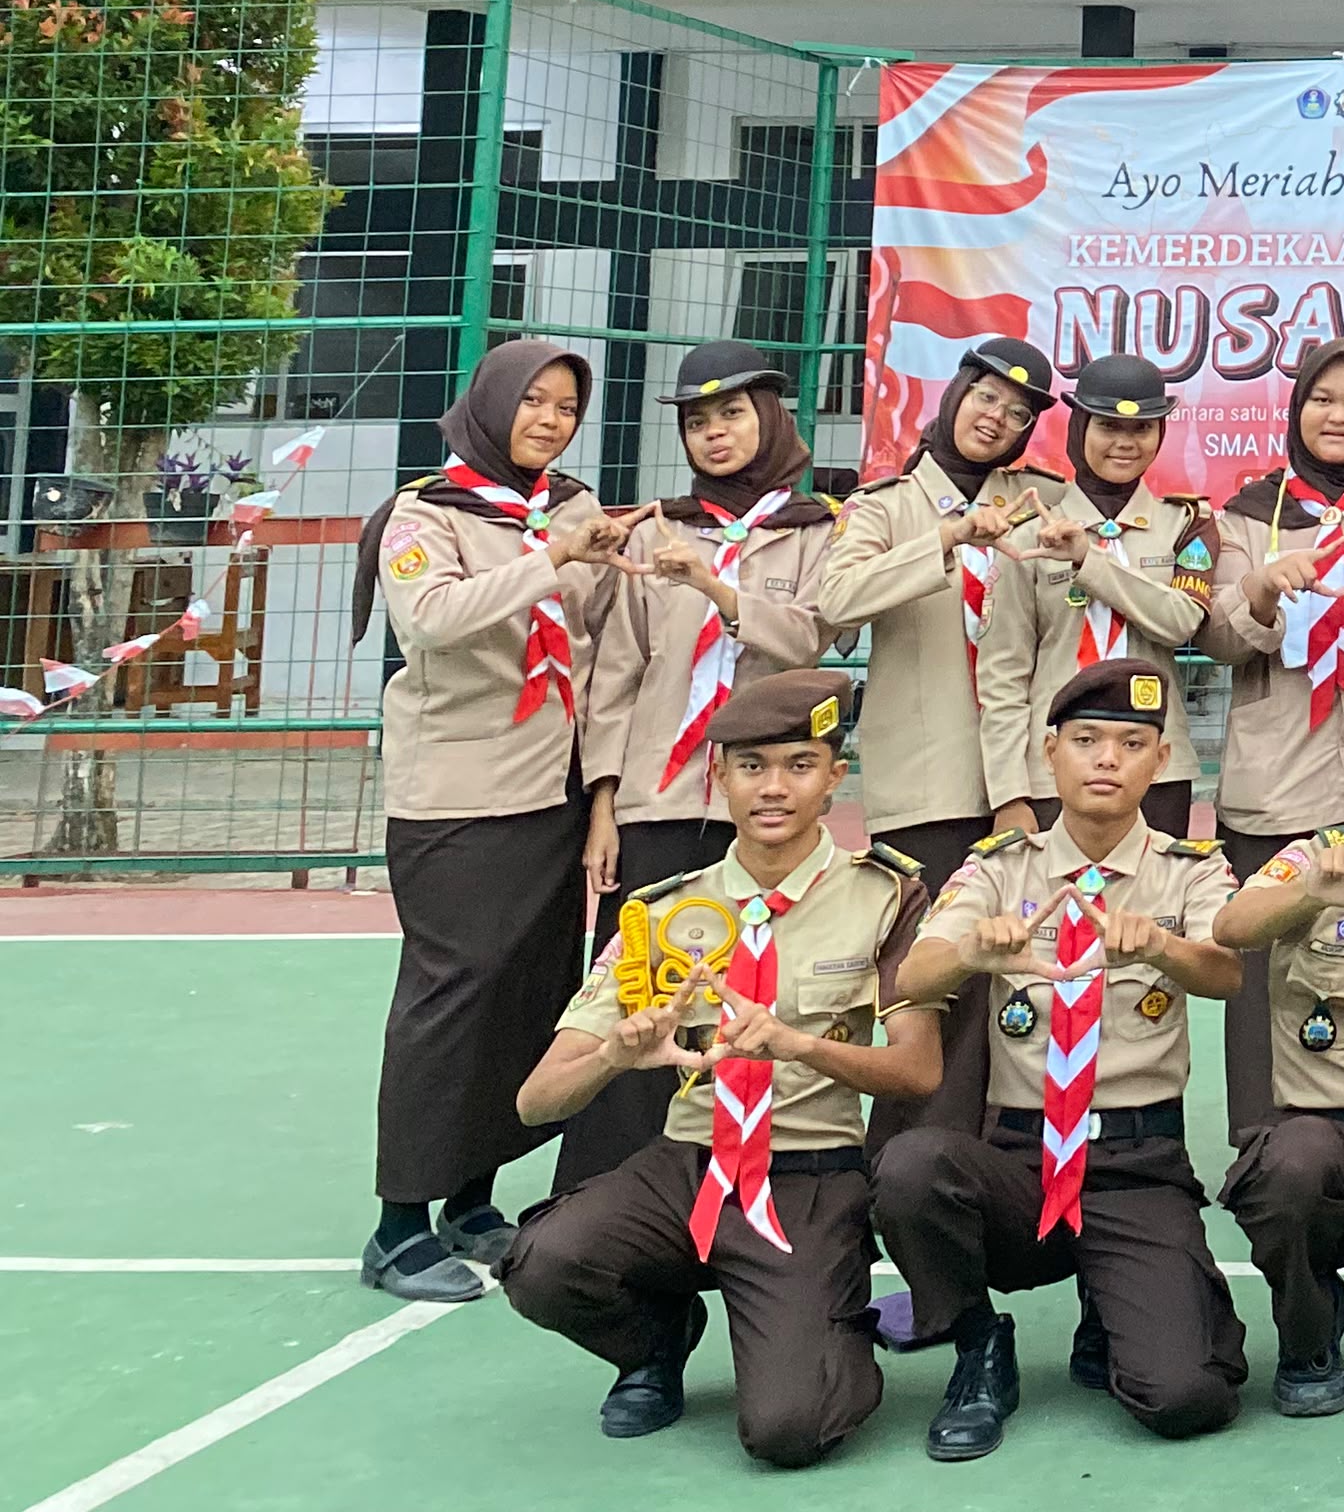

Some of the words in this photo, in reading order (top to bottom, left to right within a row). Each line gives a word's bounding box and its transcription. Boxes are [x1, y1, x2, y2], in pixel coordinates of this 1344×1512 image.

[1103, 161, 1182, 210] Ayo
[1166, 406, 1225, 422] antara
[1230, 404, 1267, 422] satu
[1204, 433, 1260, 457] SMA
